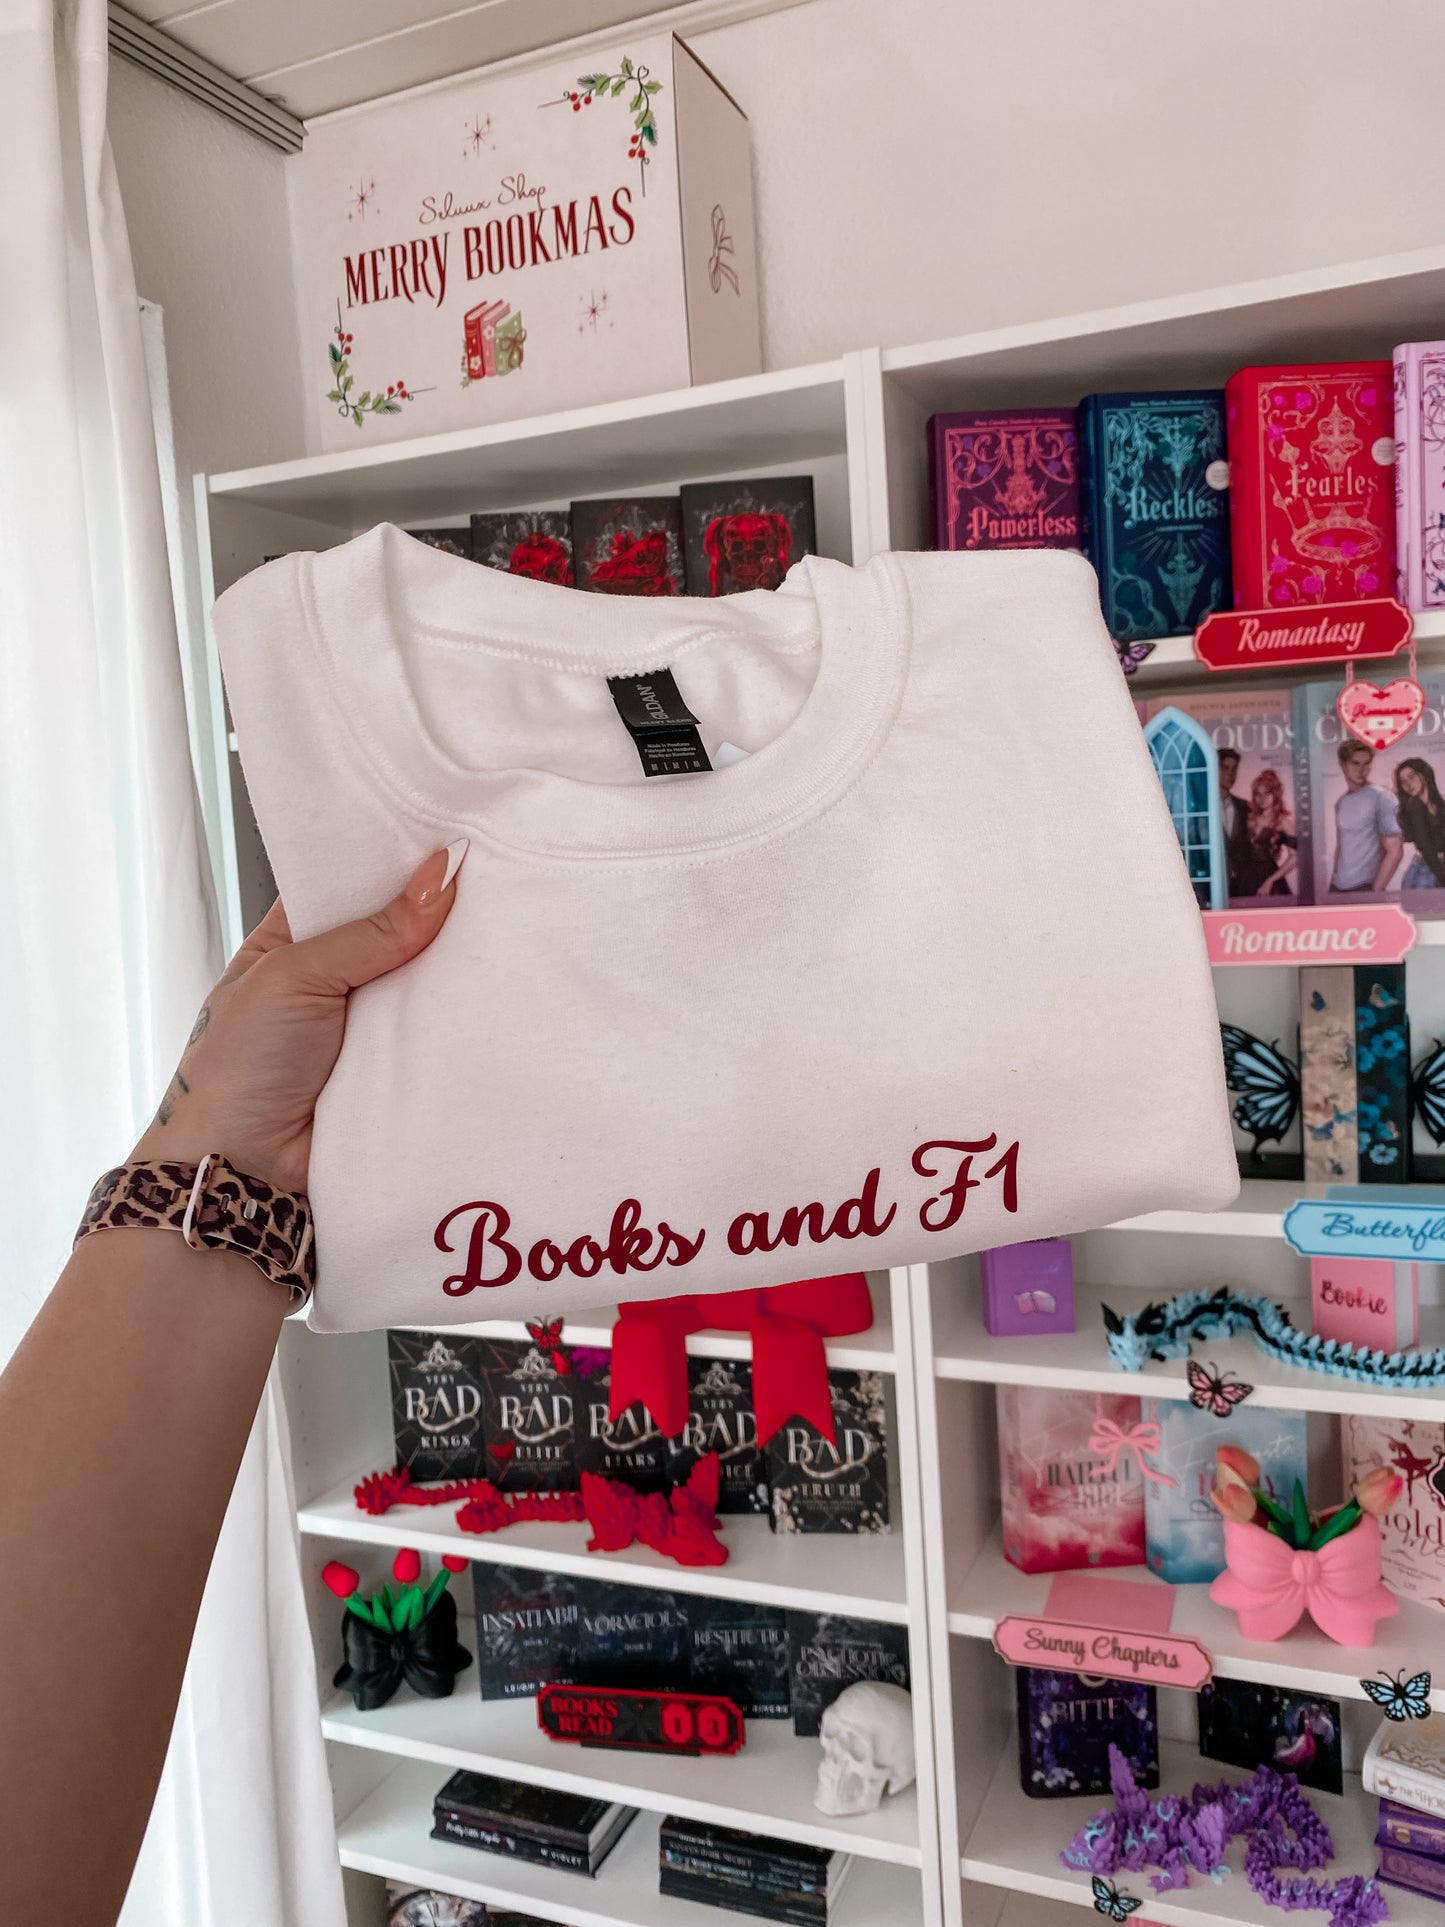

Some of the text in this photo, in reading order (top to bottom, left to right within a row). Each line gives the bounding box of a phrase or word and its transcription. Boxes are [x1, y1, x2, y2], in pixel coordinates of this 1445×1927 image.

[497, 173, 547, 209] Shop
[343, 187, 635, 308] MERRY BOOKMAS
[1285, 461, 1380, 505] Fearles
[966, 506, 1078, 548] Powerless
[1123, 486, 1219, 529] Reckles
[1237, 616, 1366, 653] Romantasy
[1211, 723, 1296, 752] OUDS
[1219, 921, 1377, 954] Romance
[433, 1131, 1020, 1298] Books and F1
[1320, 1280, 1388, 1315] Bookie
[404, 1385, 481, 1433] BAD
[500, 1396, 574, 1443] BAD
[420, 1433, 471, 1449] KINGS
[682, 1411, 757, 1458] BAD
[786, 1428, 873, 1480] BAD
[801, 1483, 862, 1497] TRUTH
[1023, 1628, 1181, 1673] Sunny Chapters
[551, 1696, 619, 1718] BOOKS
[558, 1715, 613, 1736] READ
